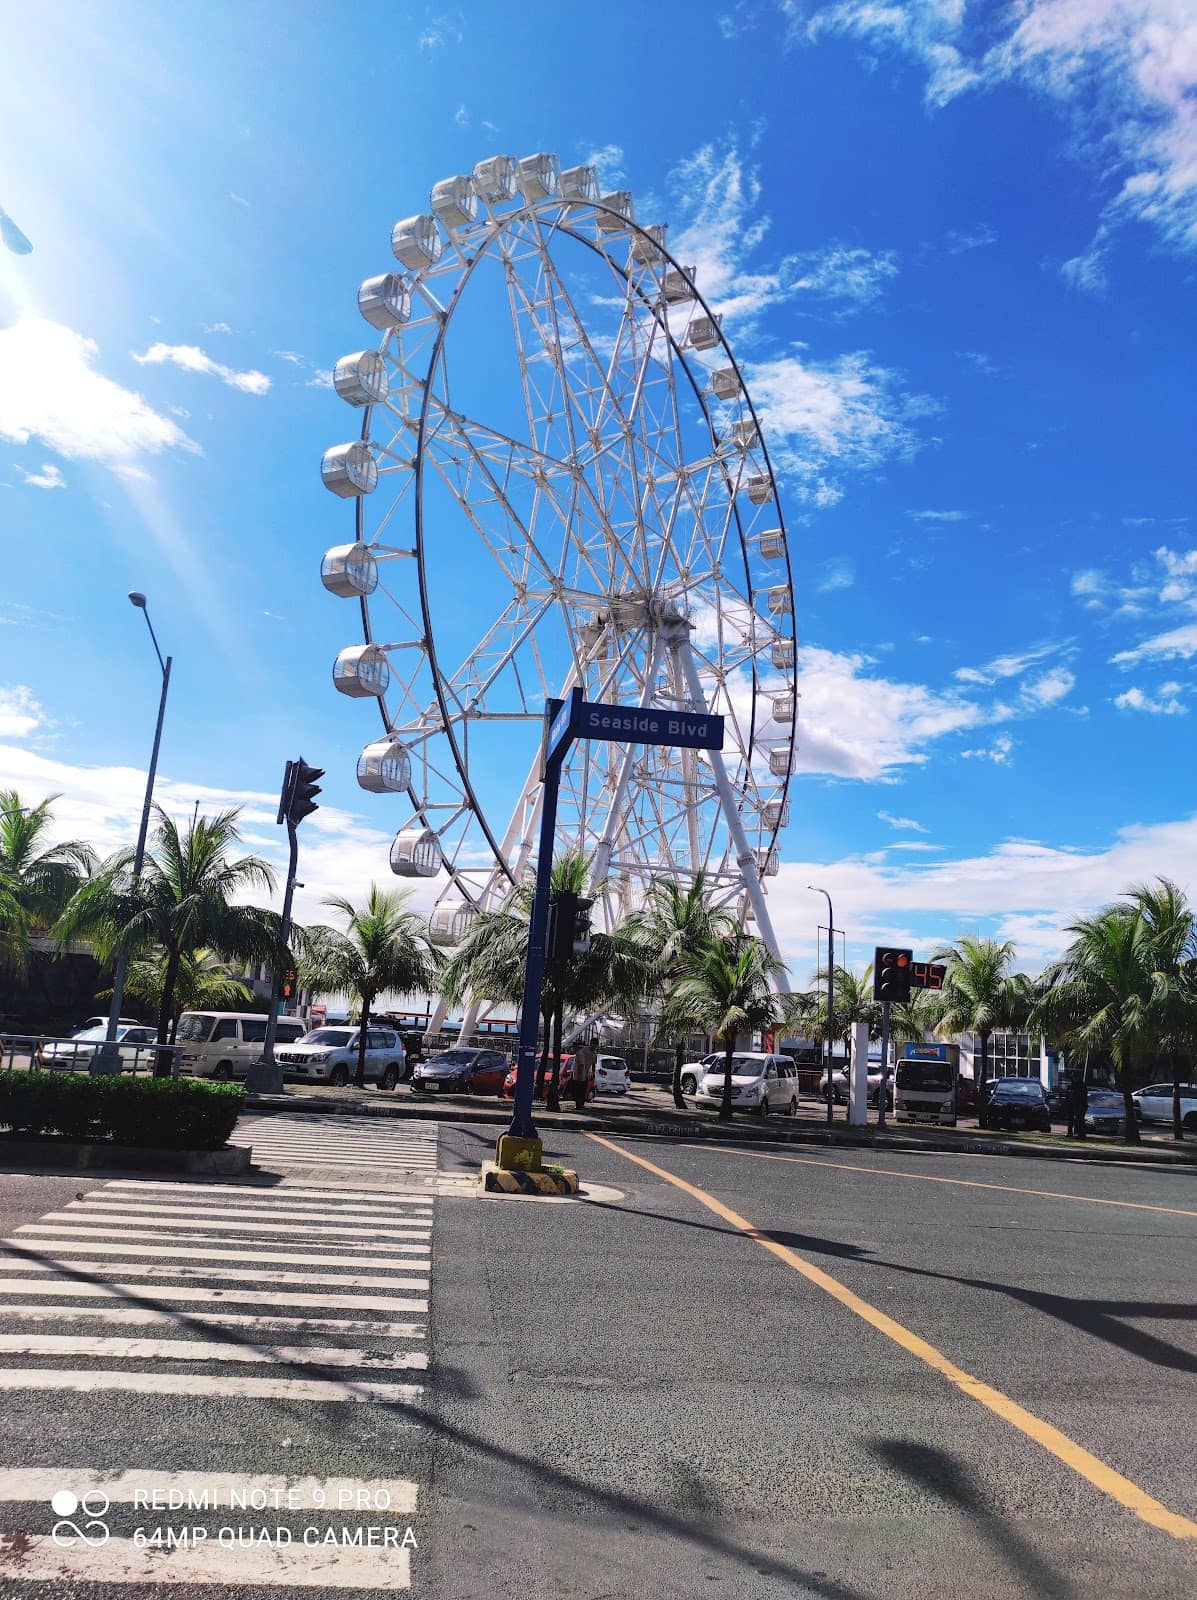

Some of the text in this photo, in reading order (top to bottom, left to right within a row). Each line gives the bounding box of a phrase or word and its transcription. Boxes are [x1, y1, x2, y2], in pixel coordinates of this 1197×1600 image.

[589, 712, 660, 733] Seaside
[667, 720, 708, 737] Blvd
[915, 964, 941, 989] 45
